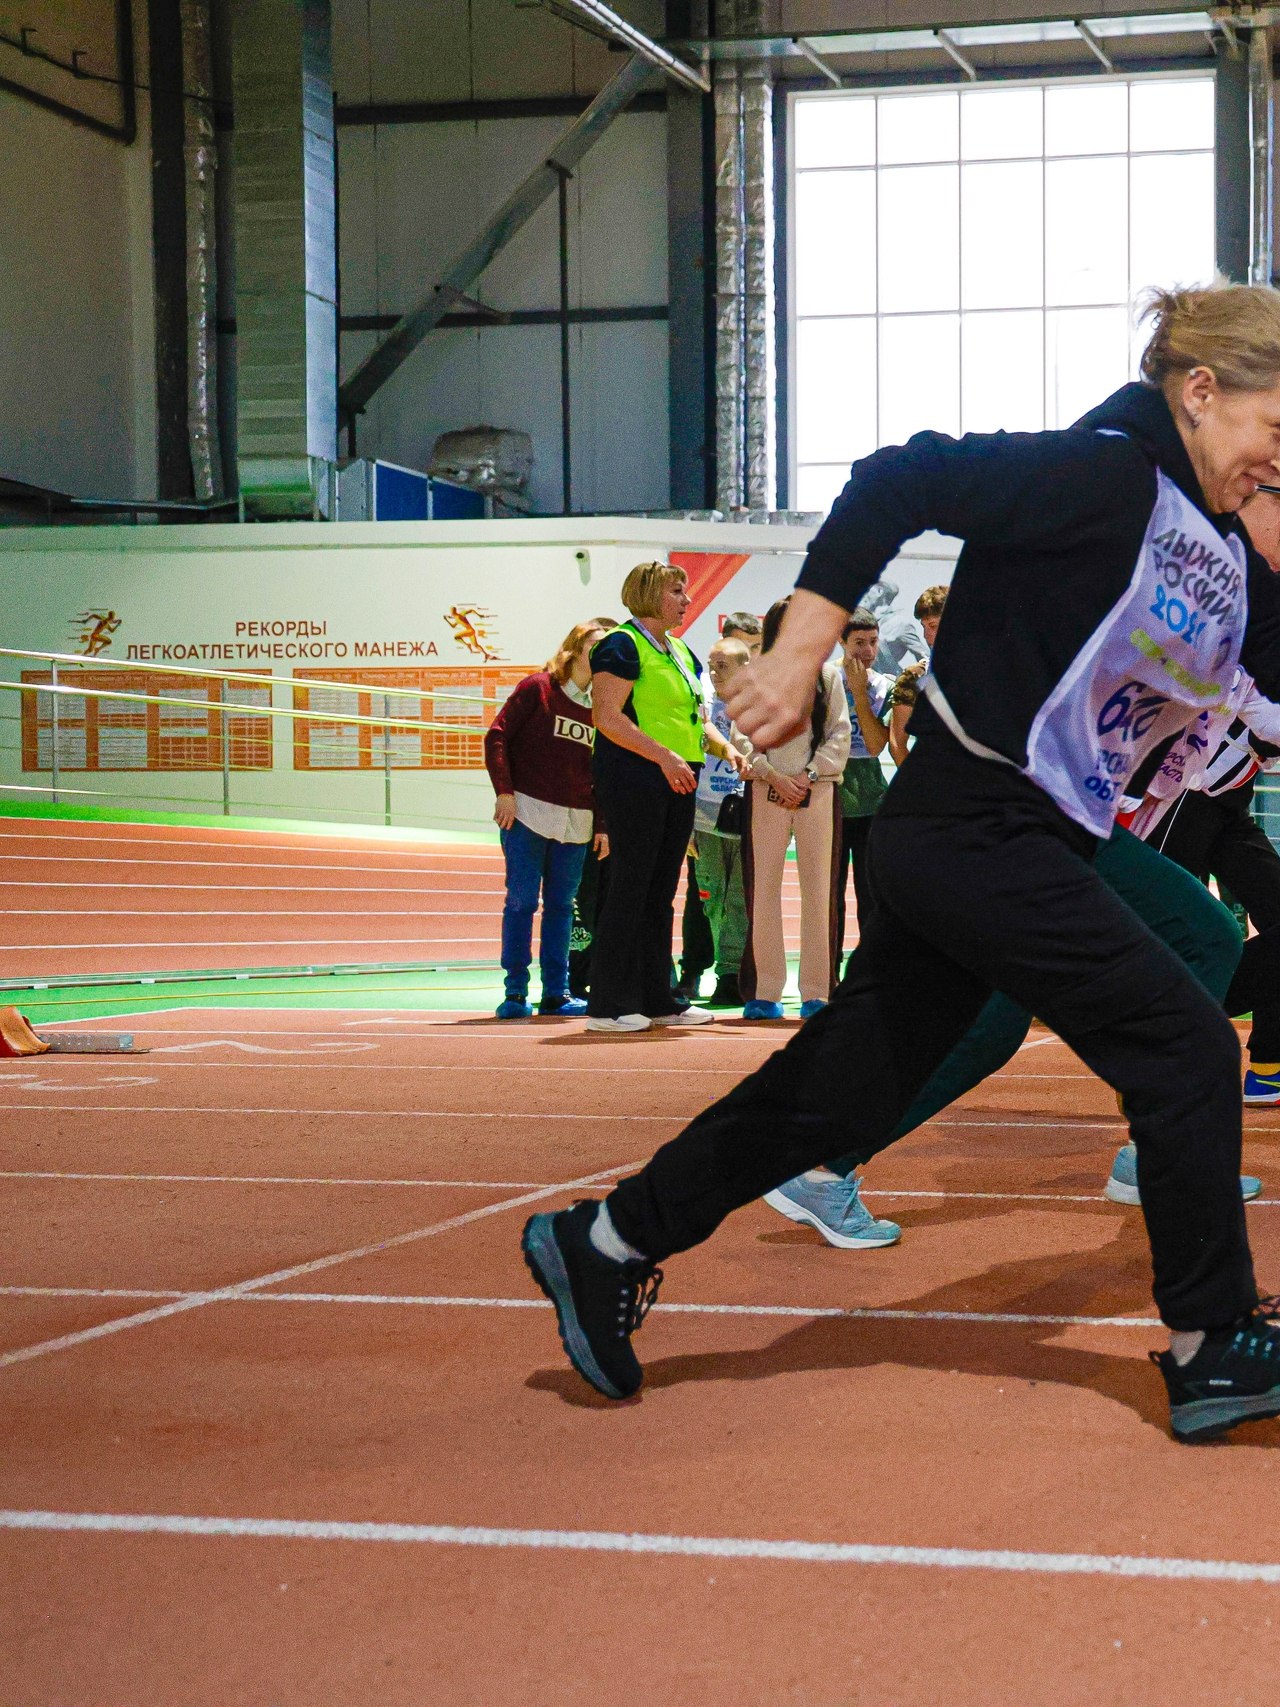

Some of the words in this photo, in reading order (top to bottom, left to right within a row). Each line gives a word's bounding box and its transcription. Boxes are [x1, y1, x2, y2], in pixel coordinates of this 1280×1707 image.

[1152, 527, 1242, 600] ЛЫЖНЯ
[235, 620, 328, 638] РЕКОРДЫ
[125, 642, 349, 660] ЛЕГКОАТЛЕТИЧЕСКОГО
[353, 640, 439, 658] МАНЕЖА
